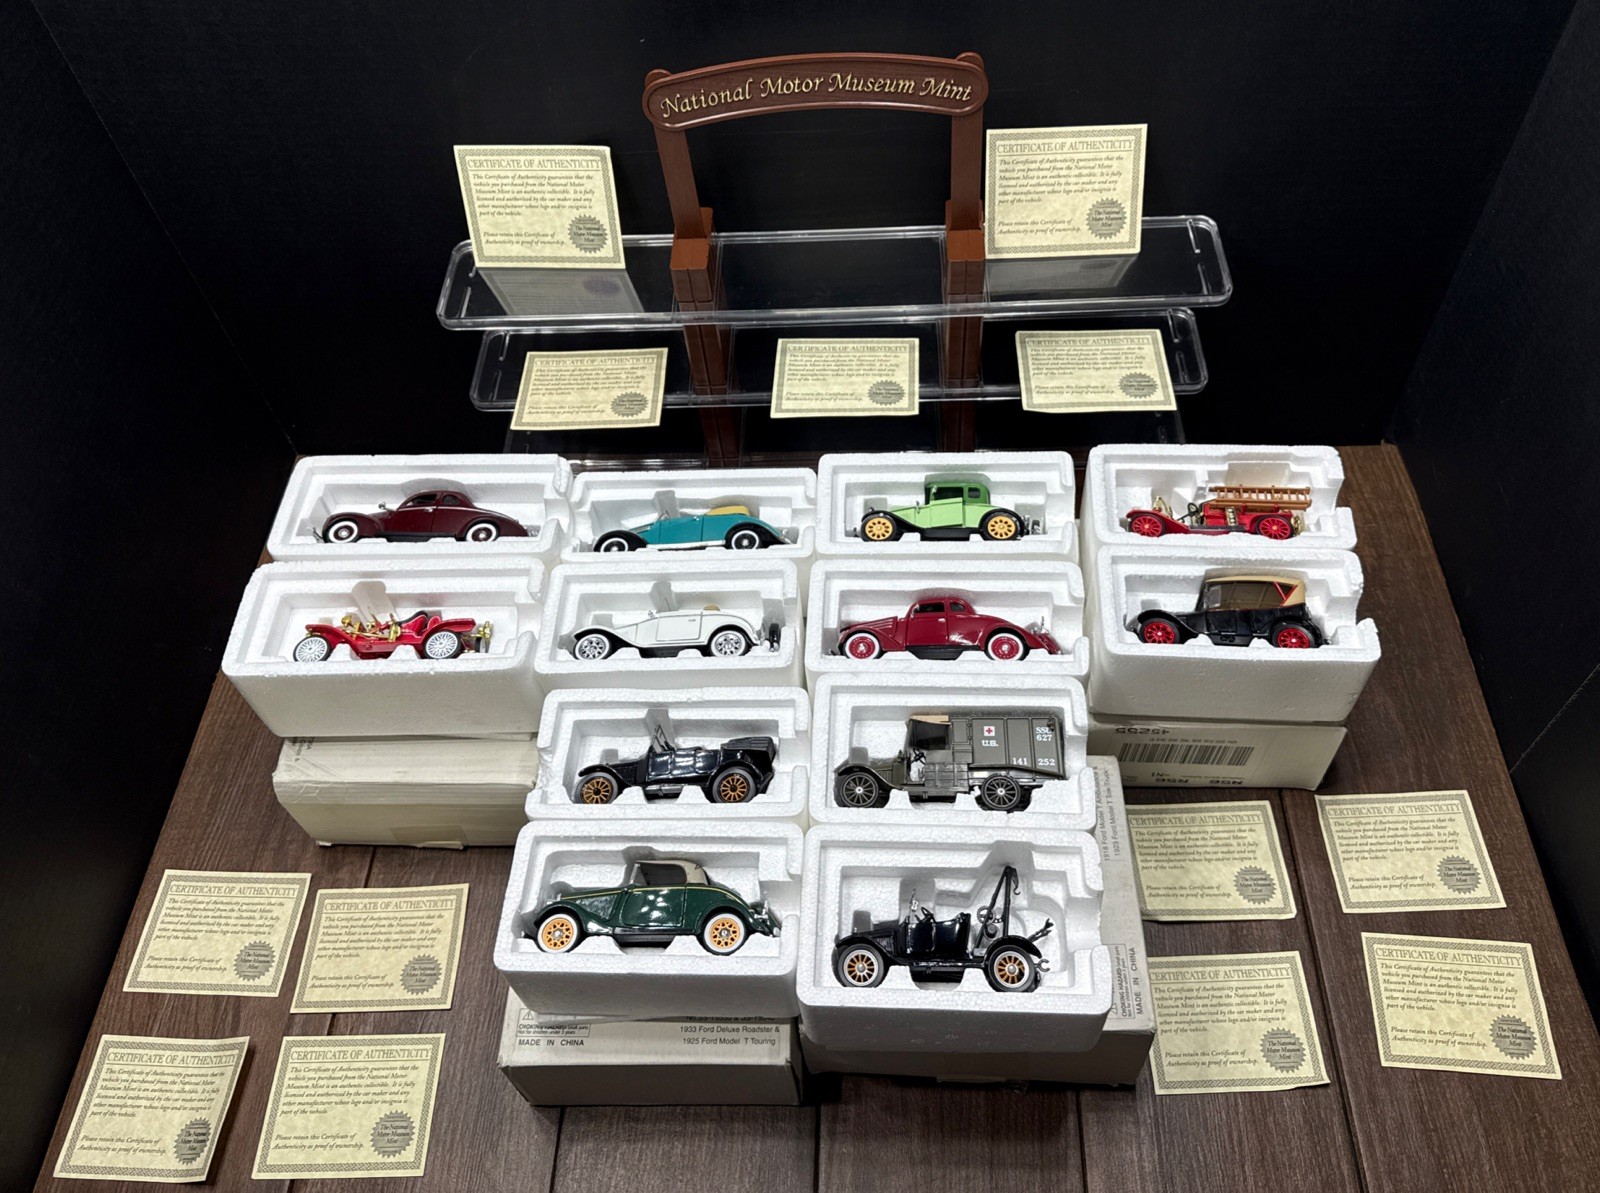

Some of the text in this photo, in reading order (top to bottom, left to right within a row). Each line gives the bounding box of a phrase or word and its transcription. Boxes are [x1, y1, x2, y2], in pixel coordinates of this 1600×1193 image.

[660, 72, 973, 118] National Motor Museum Mint
[997, 139, 1132, 153] CERTIFICATE OF AUTHENTICITY
[467, 158, 598, 168] CERTIFICATE OF AUTHENTICITY
[1328, 803, 1459, 815] CERTIFICATE OF AUTHENTICITY
[1129, 816, 1184, 825] CERTIFICATE
[1199, 813, 1260, 823] AUTHENTICITY
[1102, 846, 1110, 862] 1918
[170, 884, 295, 895] CERTIFICATE OF AUTHENTICITY
[324, 898, 452, 910] CERTIFICATE OF AUTHENTICITY
[1128, 947, 1137, 972] CHINA
[1375, 947, 1520, 965] CERTIFICATE OF AUTHENTICITY
[1148, 967, 1289, 981] CERTIFICATE OF AUTHENTICITY
[1134, 991, 1143, 1014] MADE
[751, 1038, 776, 1046] Touring
[107, 1052, 234, 1065] CERTIFICATE OF AUTHENTICITY
[290, 1048, 429, 1060] CERTIFICATE OF AUTHENTICITY
